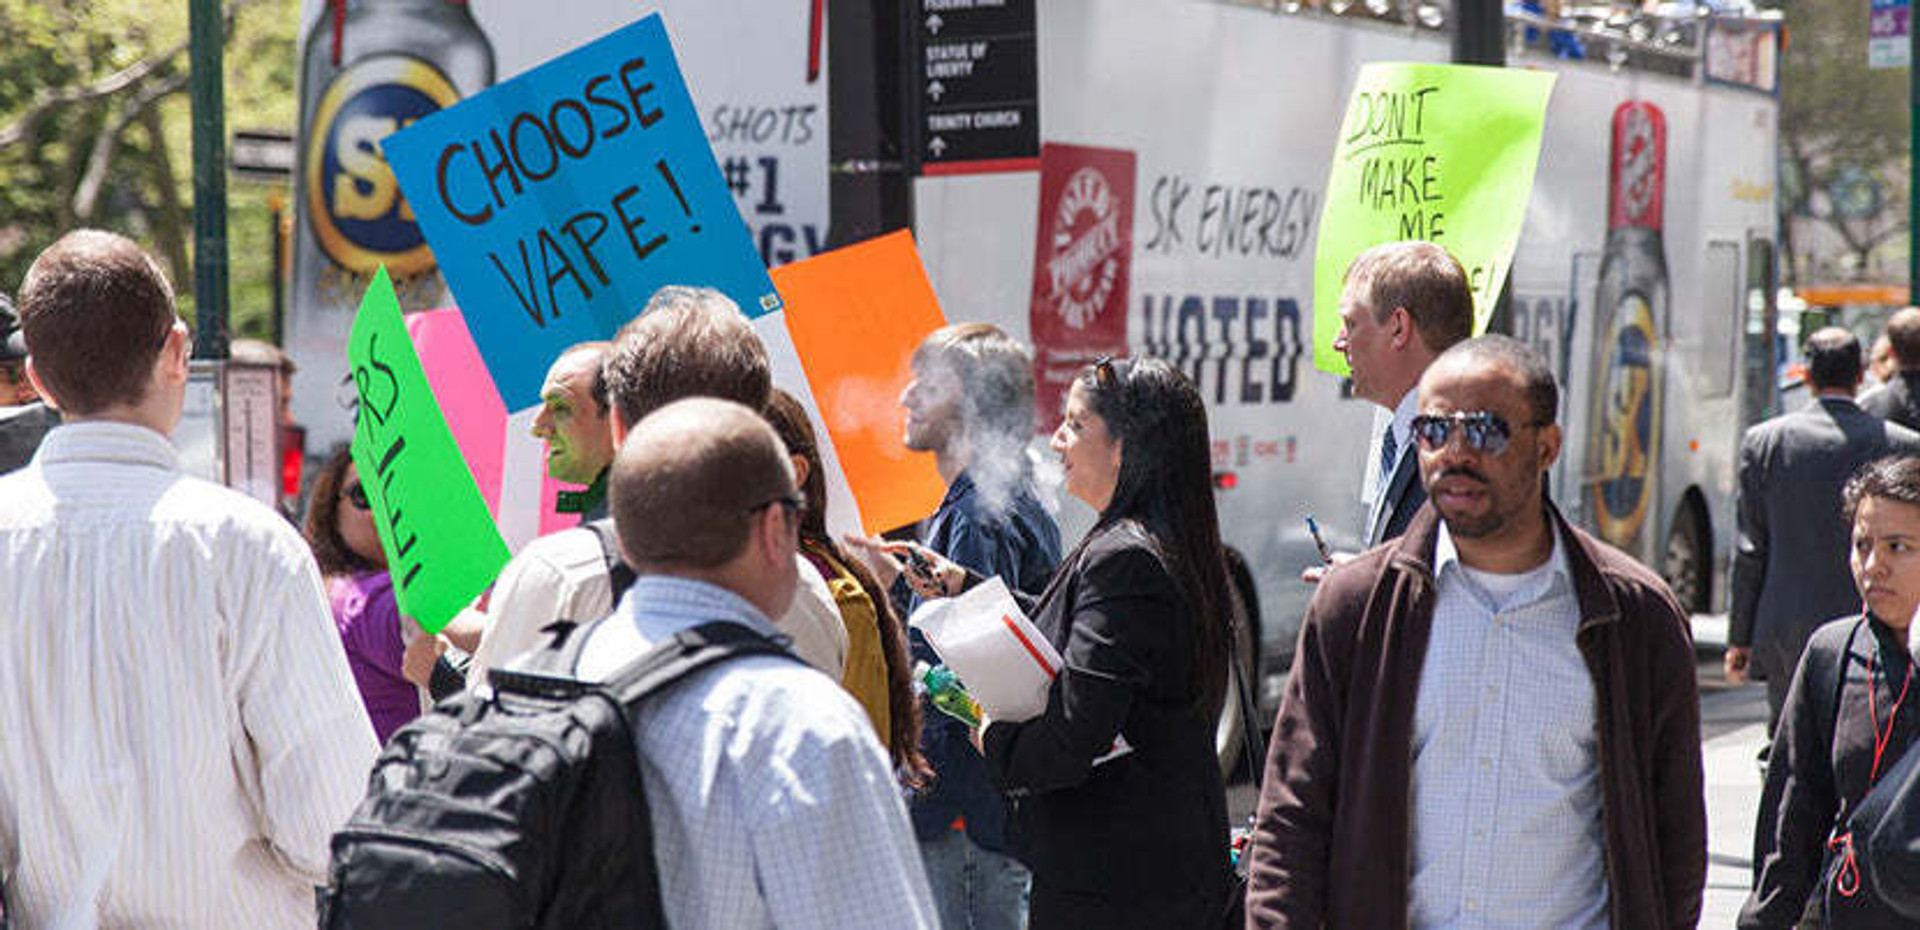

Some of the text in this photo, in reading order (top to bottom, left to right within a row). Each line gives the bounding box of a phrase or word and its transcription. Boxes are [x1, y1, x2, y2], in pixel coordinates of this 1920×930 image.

[926, 42, 987, 60] STATUE OF
[927, 61, 973, 78] LIBERTY
[436, 57, 664, 226] CHOOSE
[711, 104, 816, 145] SHOTS
[928, 111, 1020, 131] TRINITY CHURCH
[1346, 87, 1440, 144] DON'T
[724, 157, 784, 215] #1
[1359, 157, 1444, 211] MAKE
[489, 160, 701, 327] VAPE!
[1146, 176, 1189, 254] SK
[1198, 185, 1317, 259] ENERGY
[1143, 295, 1302, 403] VOTED
